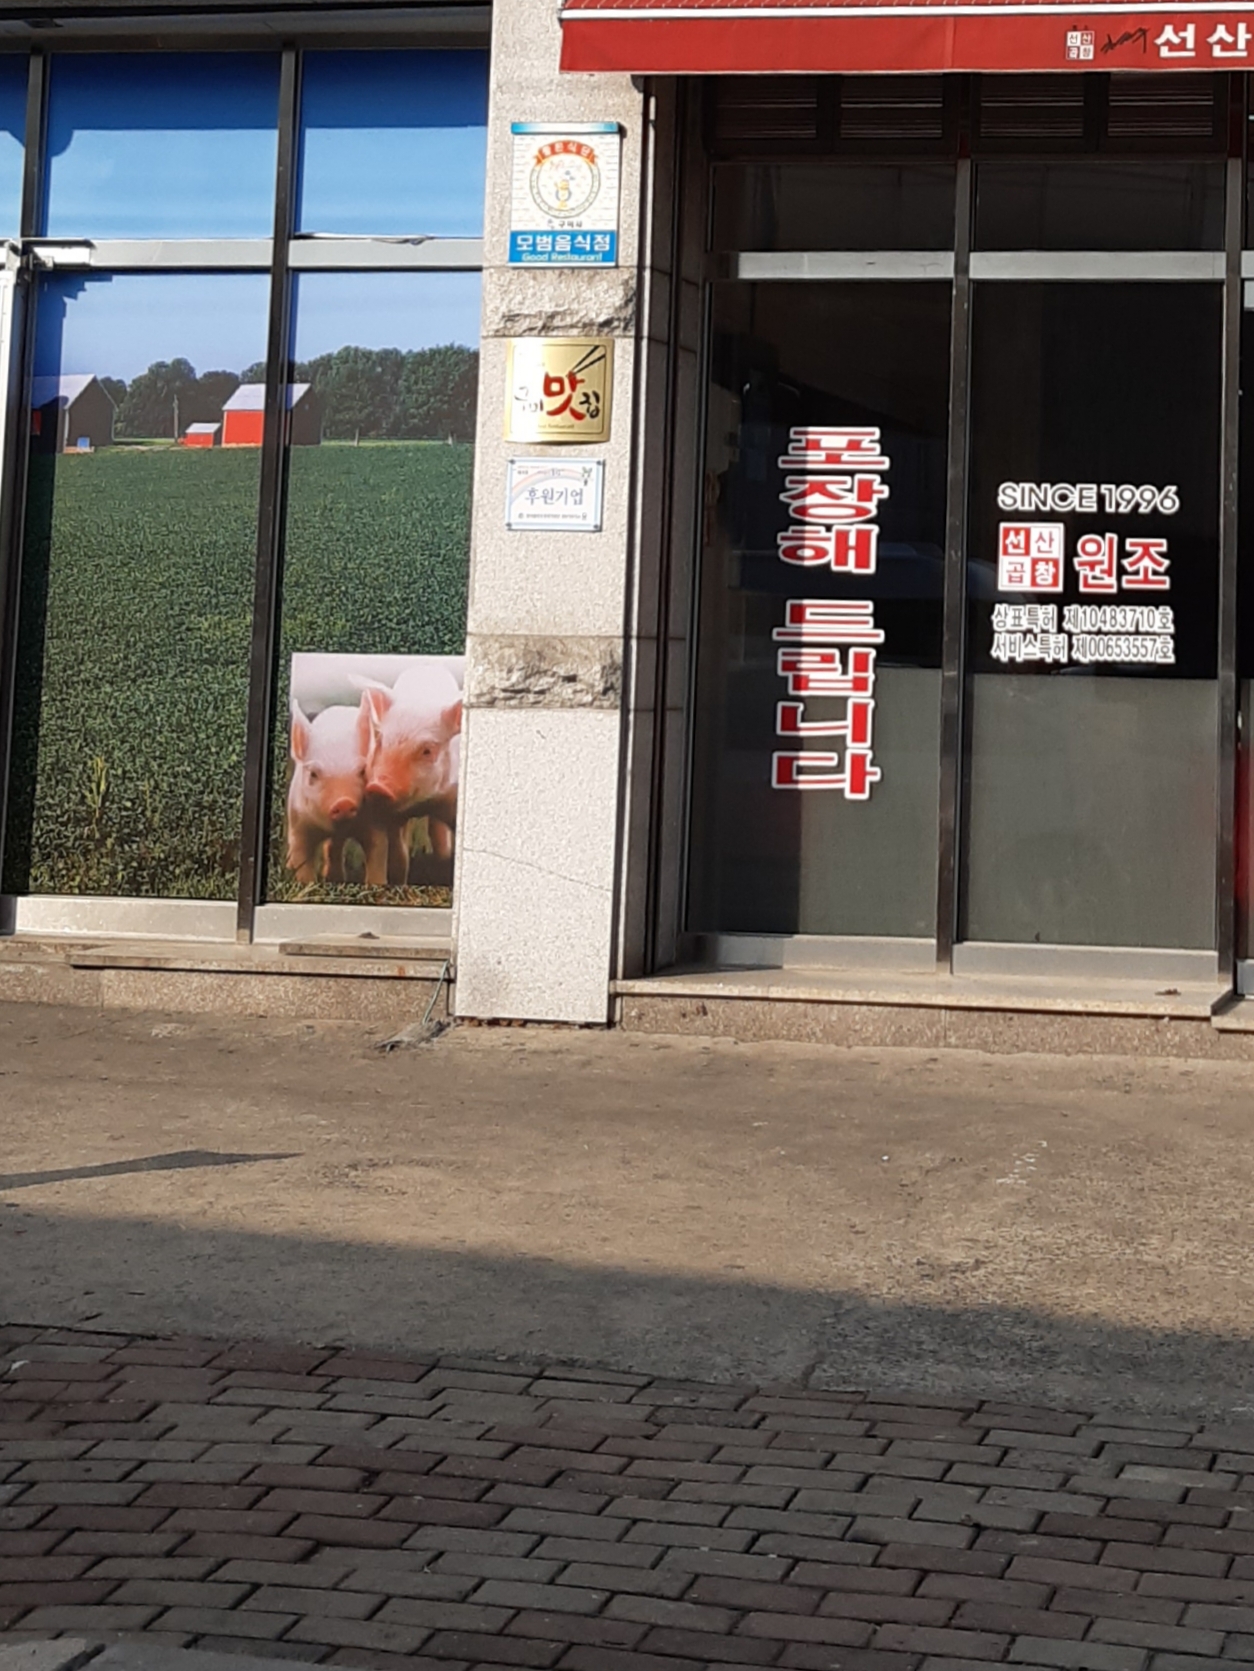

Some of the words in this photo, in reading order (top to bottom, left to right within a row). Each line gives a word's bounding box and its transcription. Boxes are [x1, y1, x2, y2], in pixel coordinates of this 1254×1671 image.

[516, 234, 610, 251] 모범음식점
[521, 253, 548, 262] Good
[526, 487, 584, 506] 후원기업
[777, 426, 890, 574] 포장해
[997, 482, 1097, 512] SINCE
[1100, 484, 1180, 514] 1996
[1073, 533, 1170, 593] 원조
[990, 603, 1057, 632] 상표특허
[990, 633, 1068, 663] 서비스특허
[772, 599, 885, 799] 드립니다
